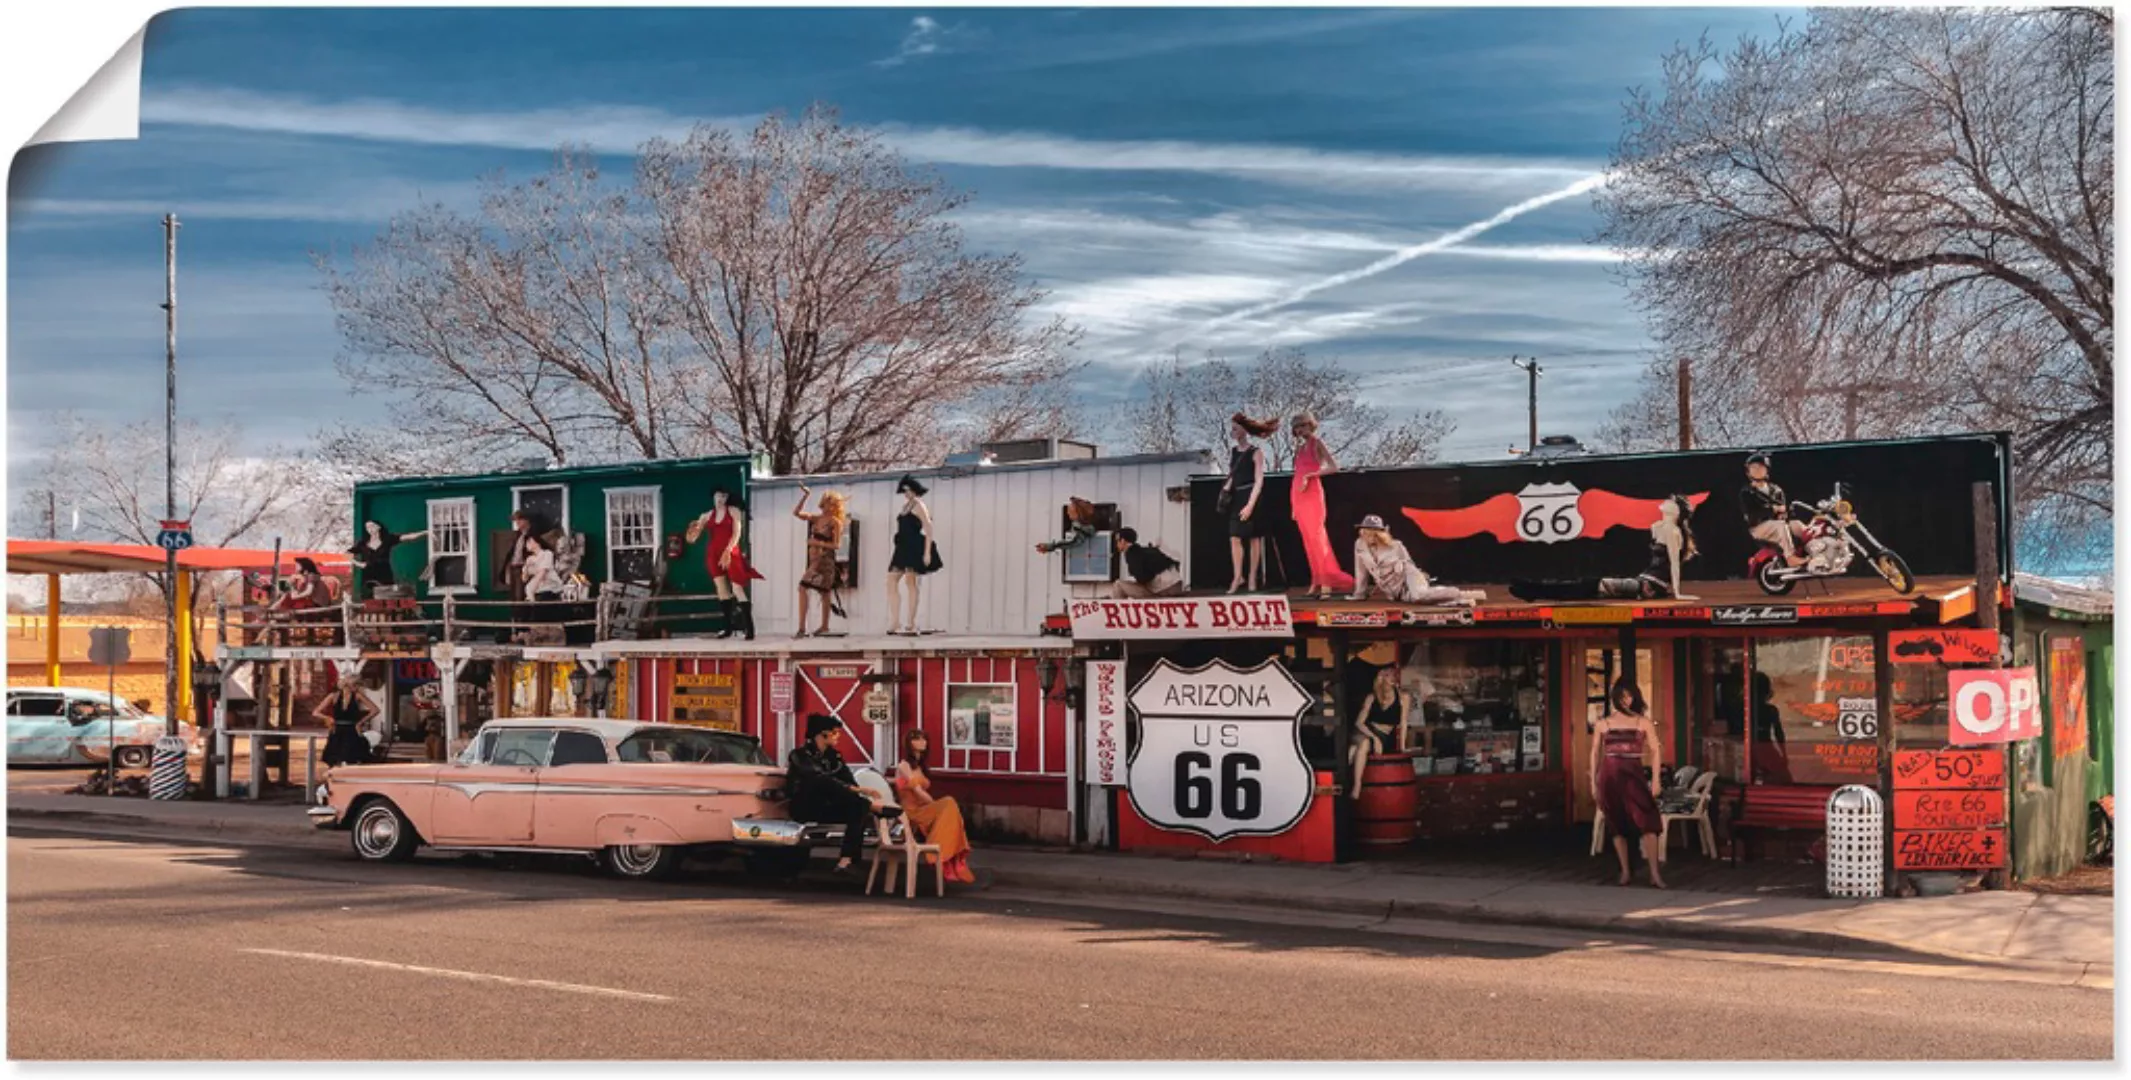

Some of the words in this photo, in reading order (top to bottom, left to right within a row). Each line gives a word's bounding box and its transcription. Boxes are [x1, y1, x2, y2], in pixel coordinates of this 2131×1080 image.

[1522, 503, 1577, 537] 66
[161, 532, 189, 549] 66
[1101, 602, 1199, 629] RUSTY
[1208, 599, 1288, 628] BOLT
[1163, 684, 1272, 708] ARIZONA
[869, 708, 889, 720] 66
[1841, 712, 1877, 736] 66
[1174, 750, 1262, 821] 66
[1961, 793, 1987, 812] 66
[1898, 832, 1976, 854] BIKER
